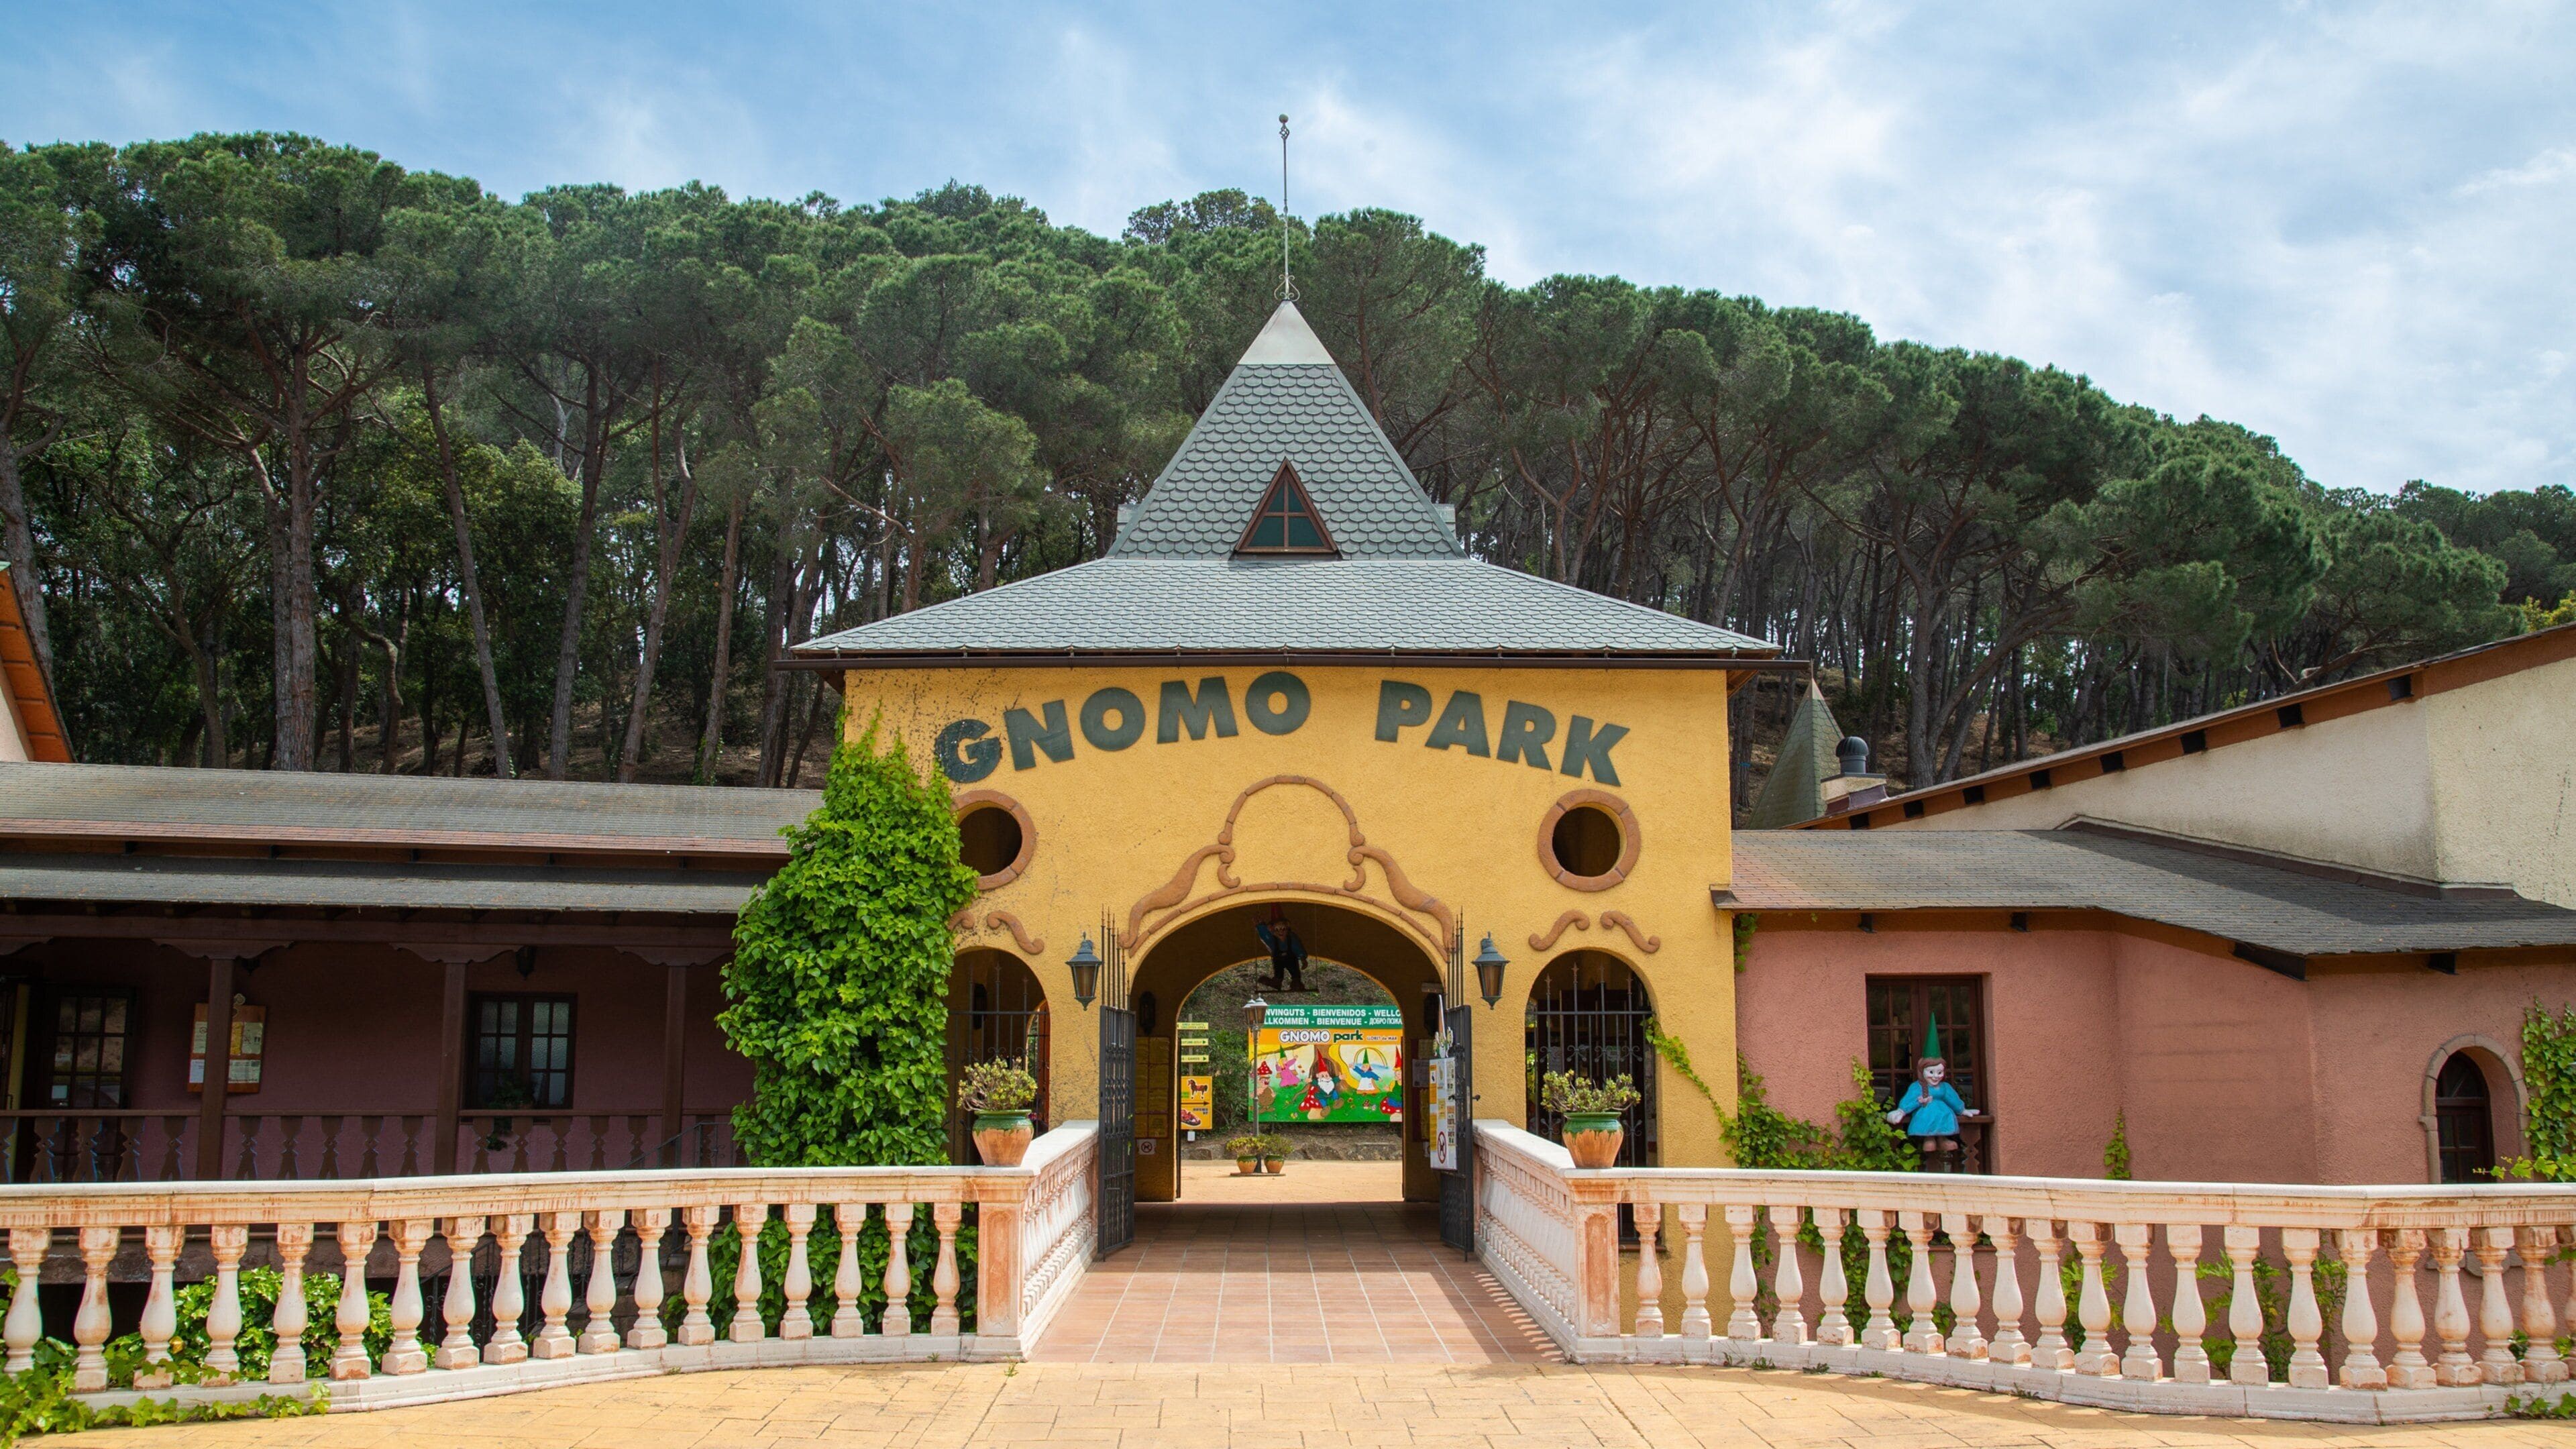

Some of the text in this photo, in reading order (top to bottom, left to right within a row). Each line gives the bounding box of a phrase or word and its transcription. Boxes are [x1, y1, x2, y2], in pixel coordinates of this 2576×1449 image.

[934, 671, 1630, 787] GNOMO PARK
[1312, 1008, 1366, 1017] BIENVENIDOS
[1317, 1018, 1362, 1026] BIENVENUE
[1279, 1030, 1330, 1043] GNOMO
[1334, 1030, 1363, 1043] park
